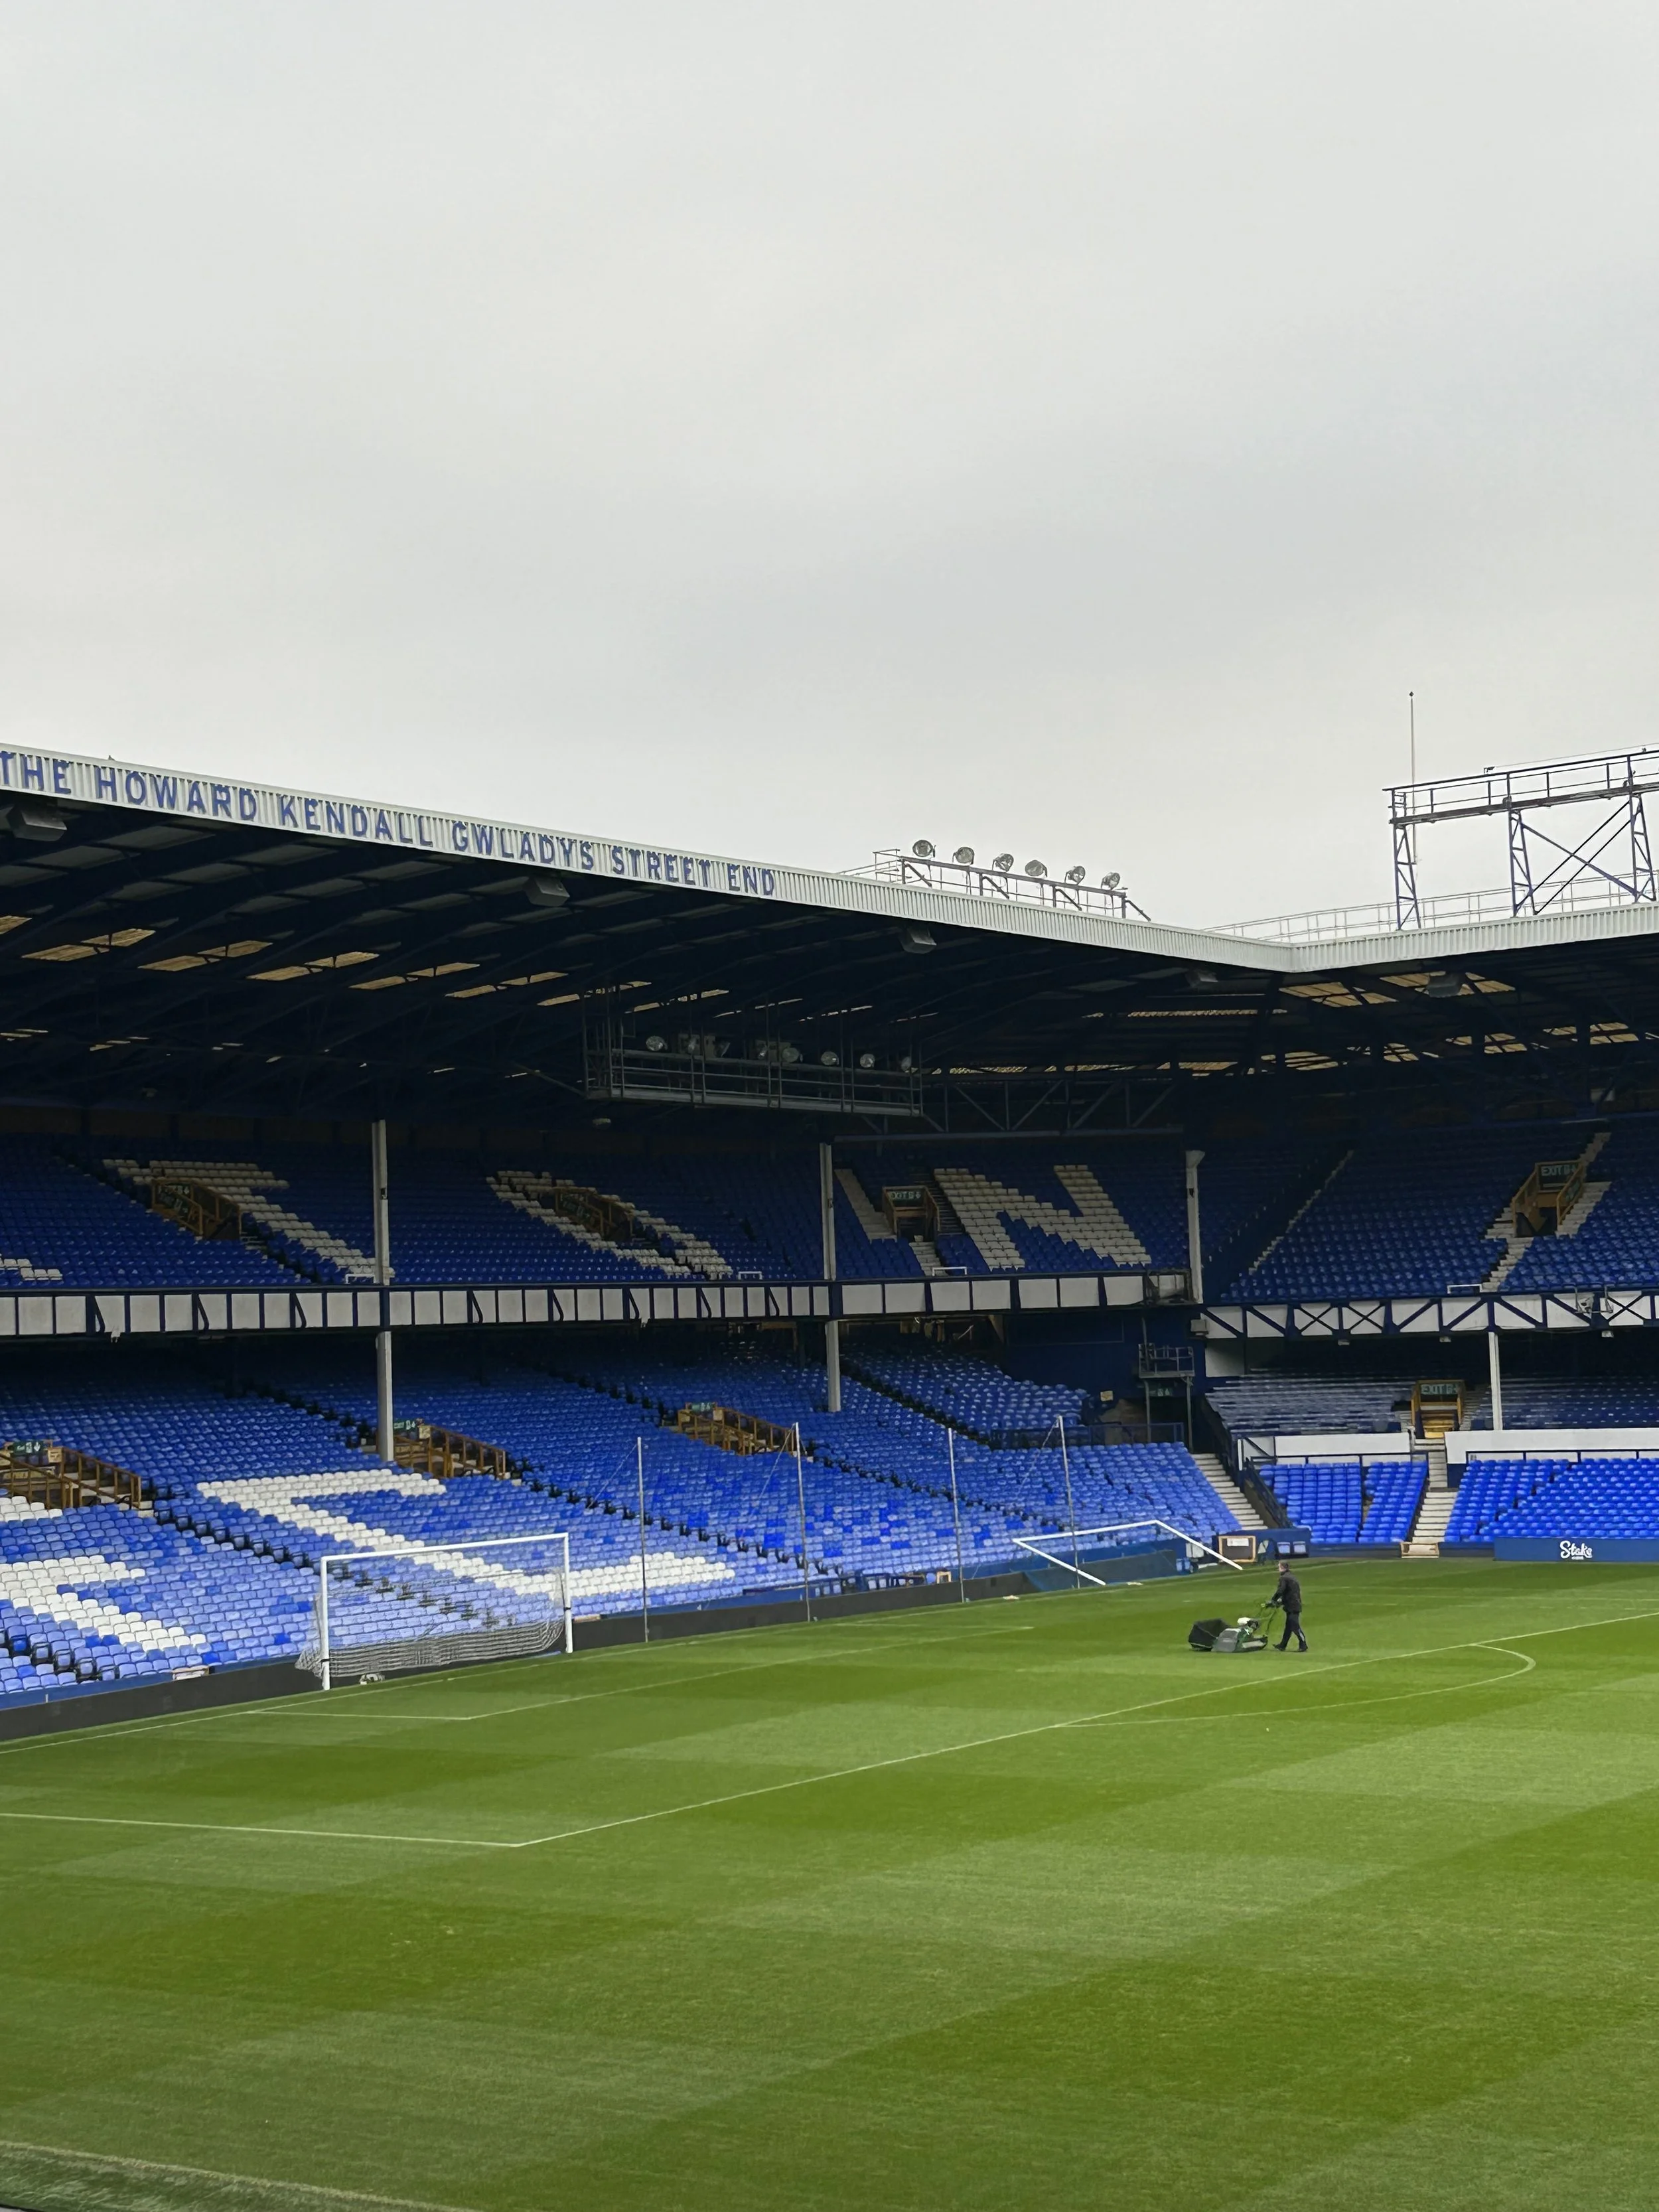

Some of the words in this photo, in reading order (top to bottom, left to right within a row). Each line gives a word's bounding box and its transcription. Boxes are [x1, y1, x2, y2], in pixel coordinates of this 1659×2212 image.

[0, 751, 71, 794] THE
[95, 765, 257, 821] HOWARD
[279, 794, 433, 848] KENDALL
[452, 820, 594, 871] GWLADYS
[611, 846, 710, 888] STREET
[727, 863, 774, 896] END
[1559, 1540, 1593, 1558] Stake
